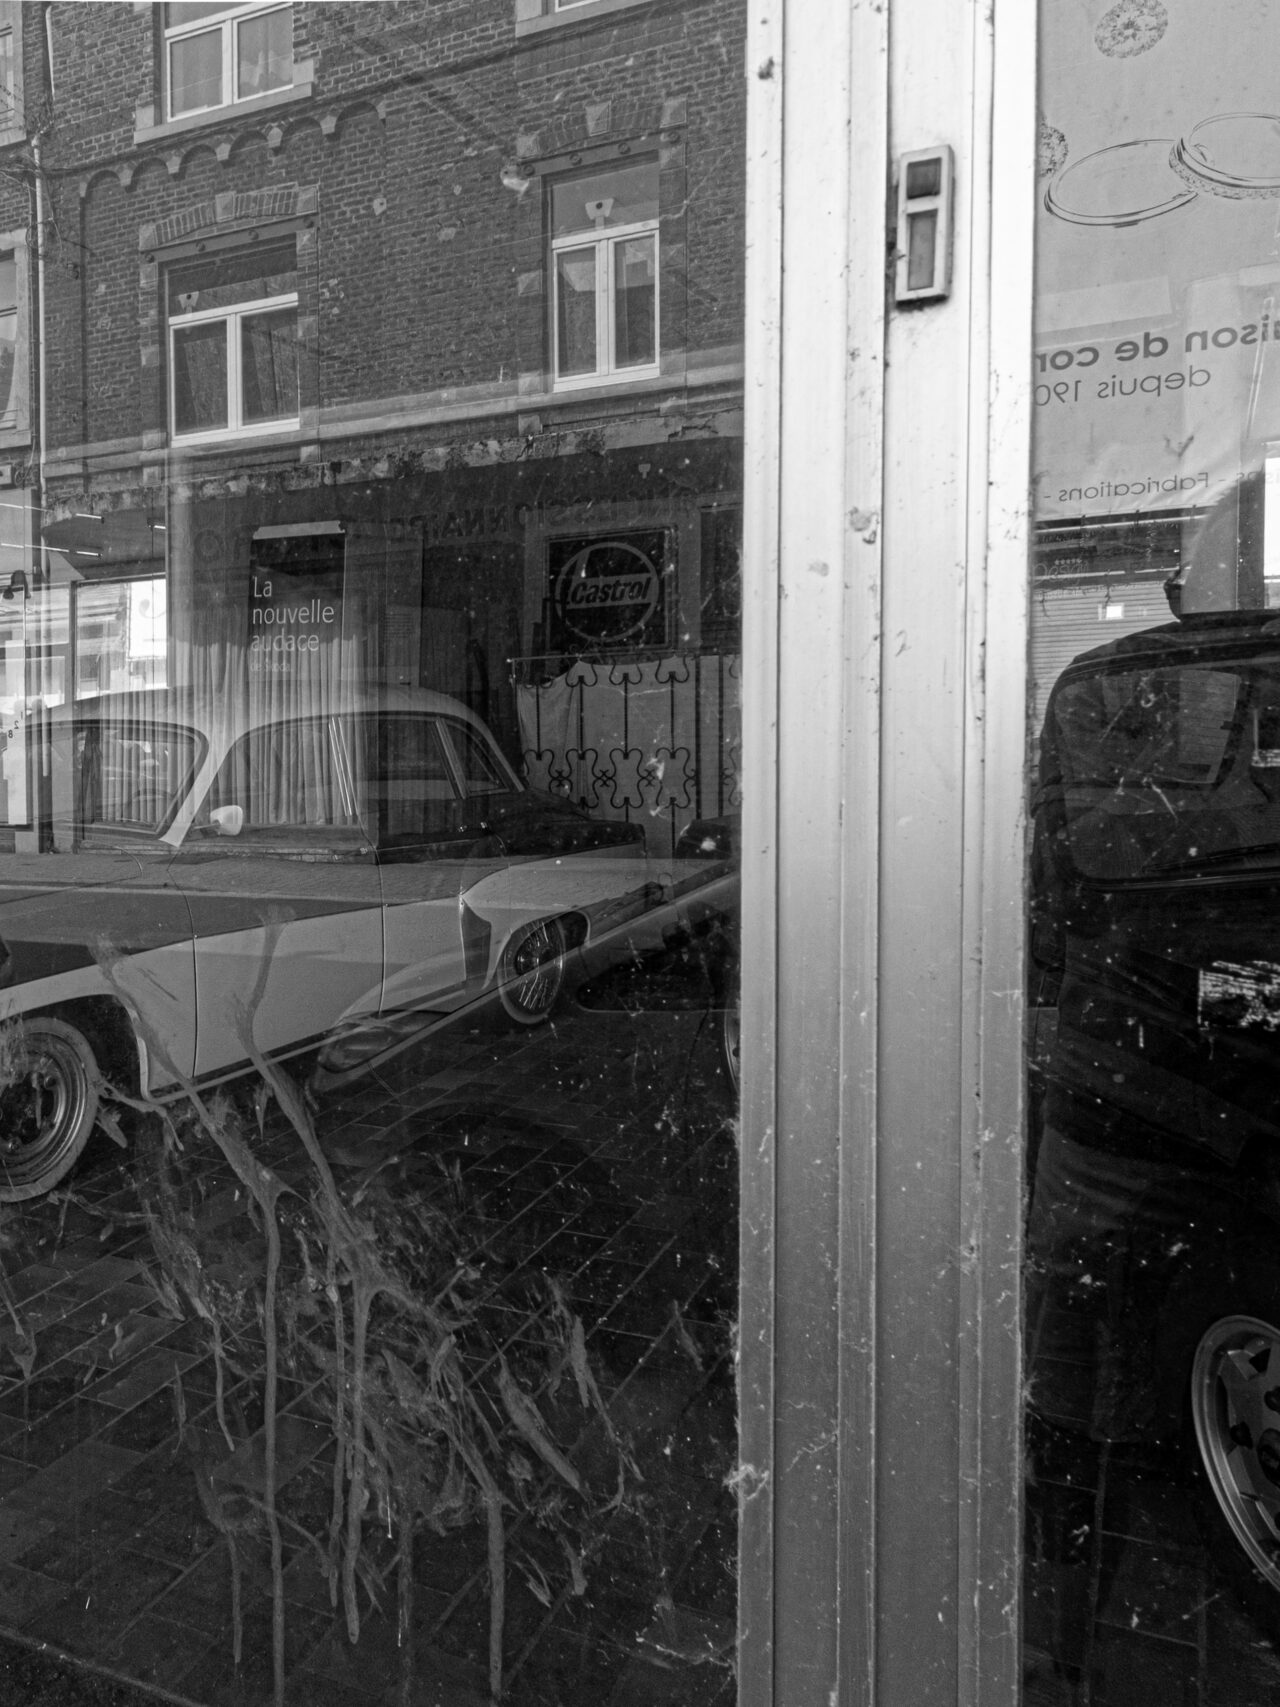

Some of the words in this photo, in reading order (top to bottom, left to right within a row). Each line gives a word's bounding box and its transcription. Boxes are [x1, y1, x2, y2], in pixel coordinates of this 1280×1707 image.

[253, 576, 272, 598] La
[570, 577, 652, 604] Castrol
[252, 598, 335, 625] nouvelle
[251, 627, 319, 652] audace
